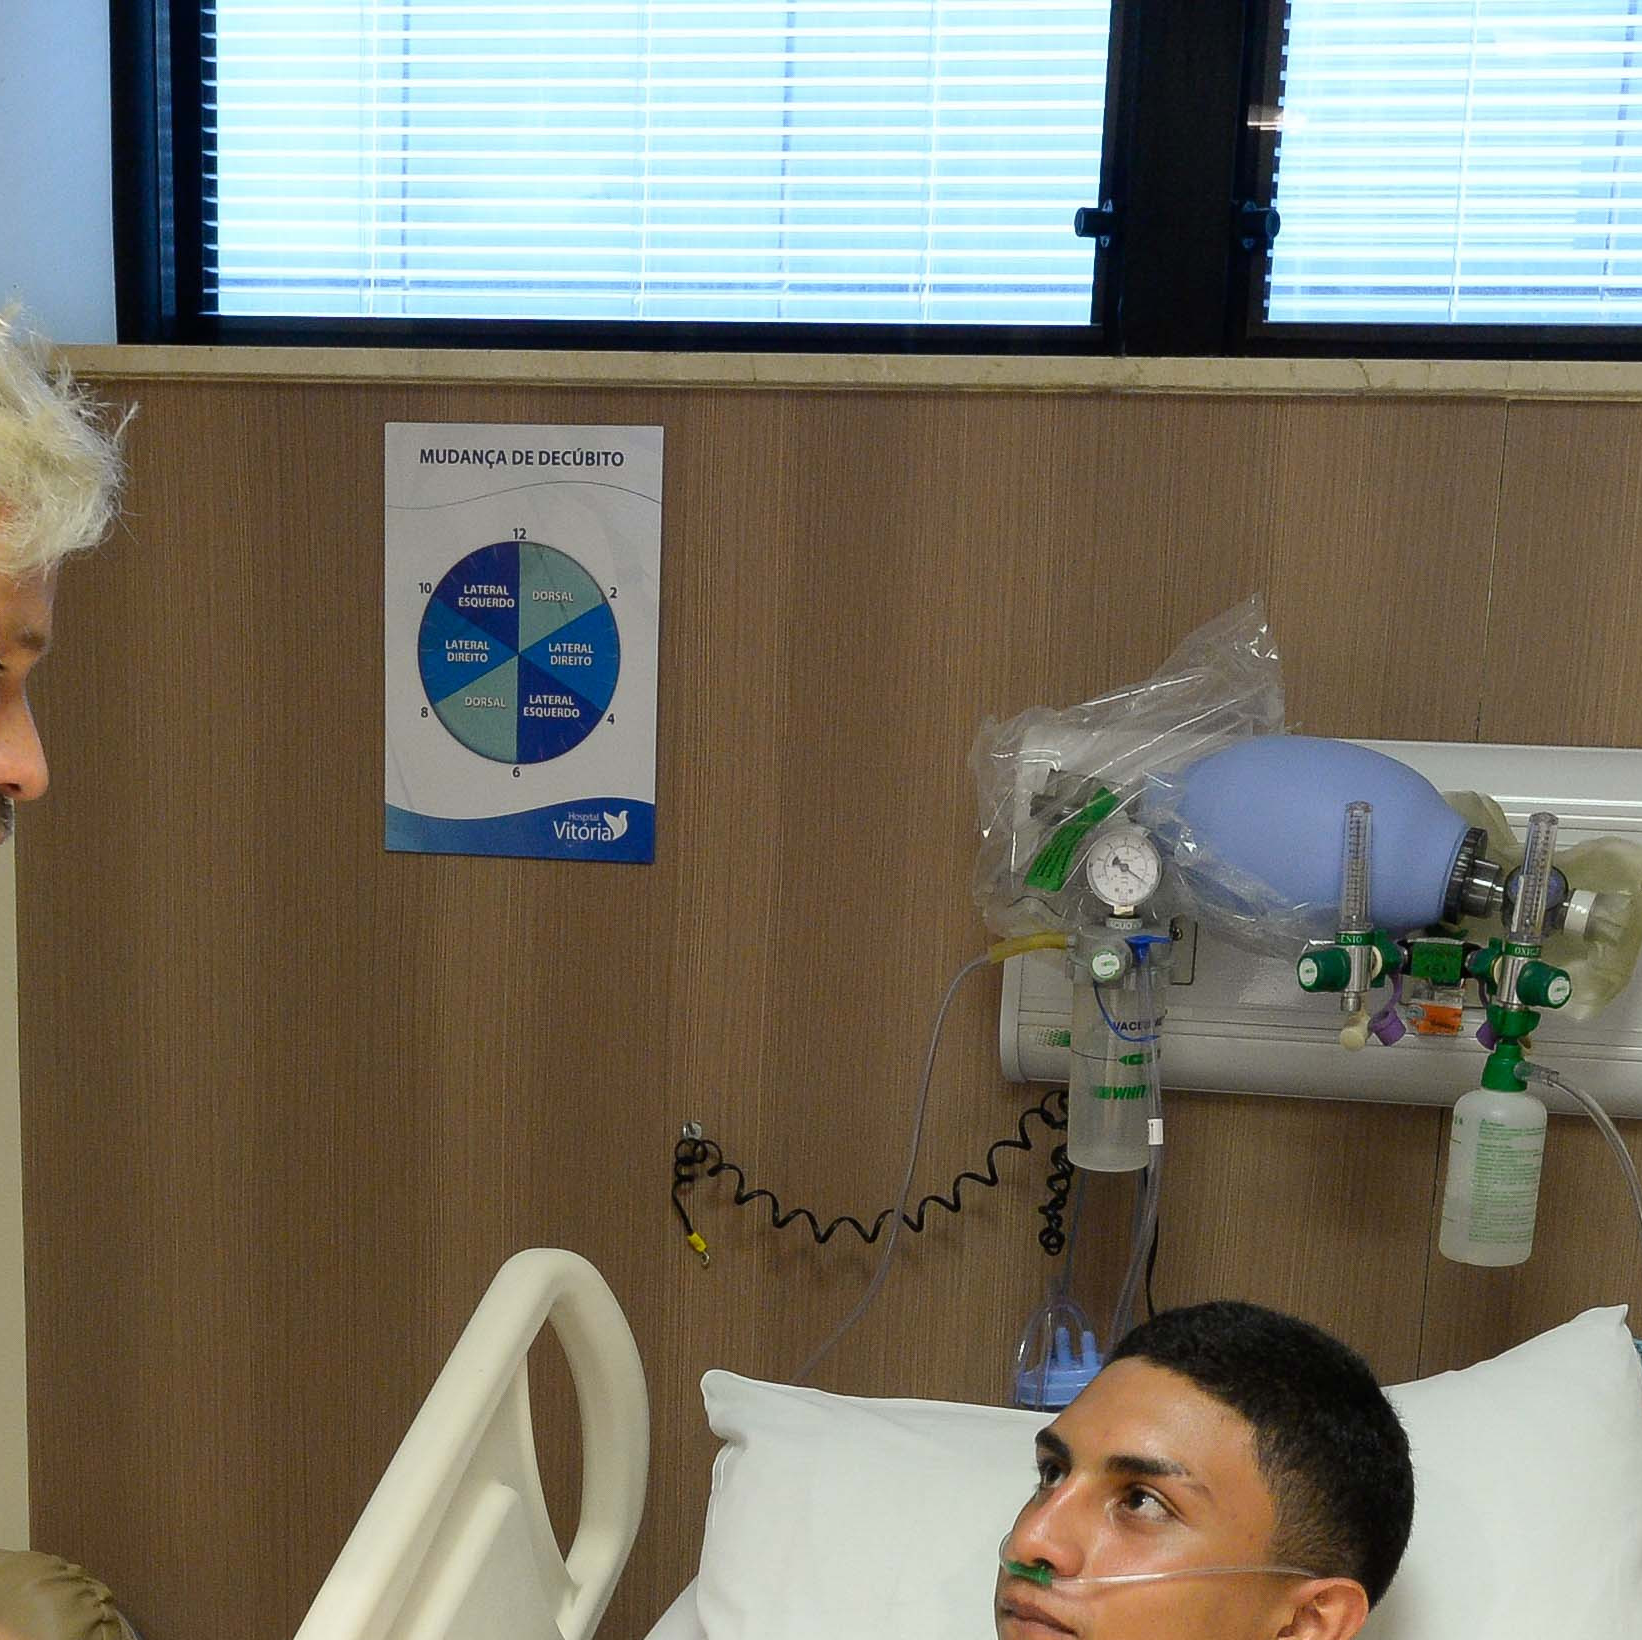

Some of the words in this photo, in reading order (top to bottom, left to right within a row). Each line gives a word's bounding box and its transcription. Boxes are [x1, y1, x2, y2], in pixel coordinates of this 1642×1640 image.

[420, 448, 507, 469] MUDANÇA
[511, 450, 534, 466] DE
[538, 447, 624, 467] DECÚBITO
[513, 528, 527, 540] 12
[418, 583, 432, 594] 10
[463, 584, 509, 596] LATERAL
[609, 587, 618, 599] 2
[532, 591, 574, 602] DORSAL
[458, 597, 515, 608] ESQUERDO
[445, 639, 490, 650] LATERAL
[548, 643, 594, 654] LATERAL
[447, 652, 489, 663] DIREITO
[550, 655, 592, 666] DIREITO
[464, 696, 506, 708] DORSAL
[529, 695, 575, 706] LATERAL
[420, 707, 429, 718] 8
[523, 707, 580, 719] ESQUERDO
[606, 713, 615, 725] 4
[512, 766, 521, 778] 6
[568, 811, 599, 822] Hospital
[553, 820, 612, 842] Vitória
